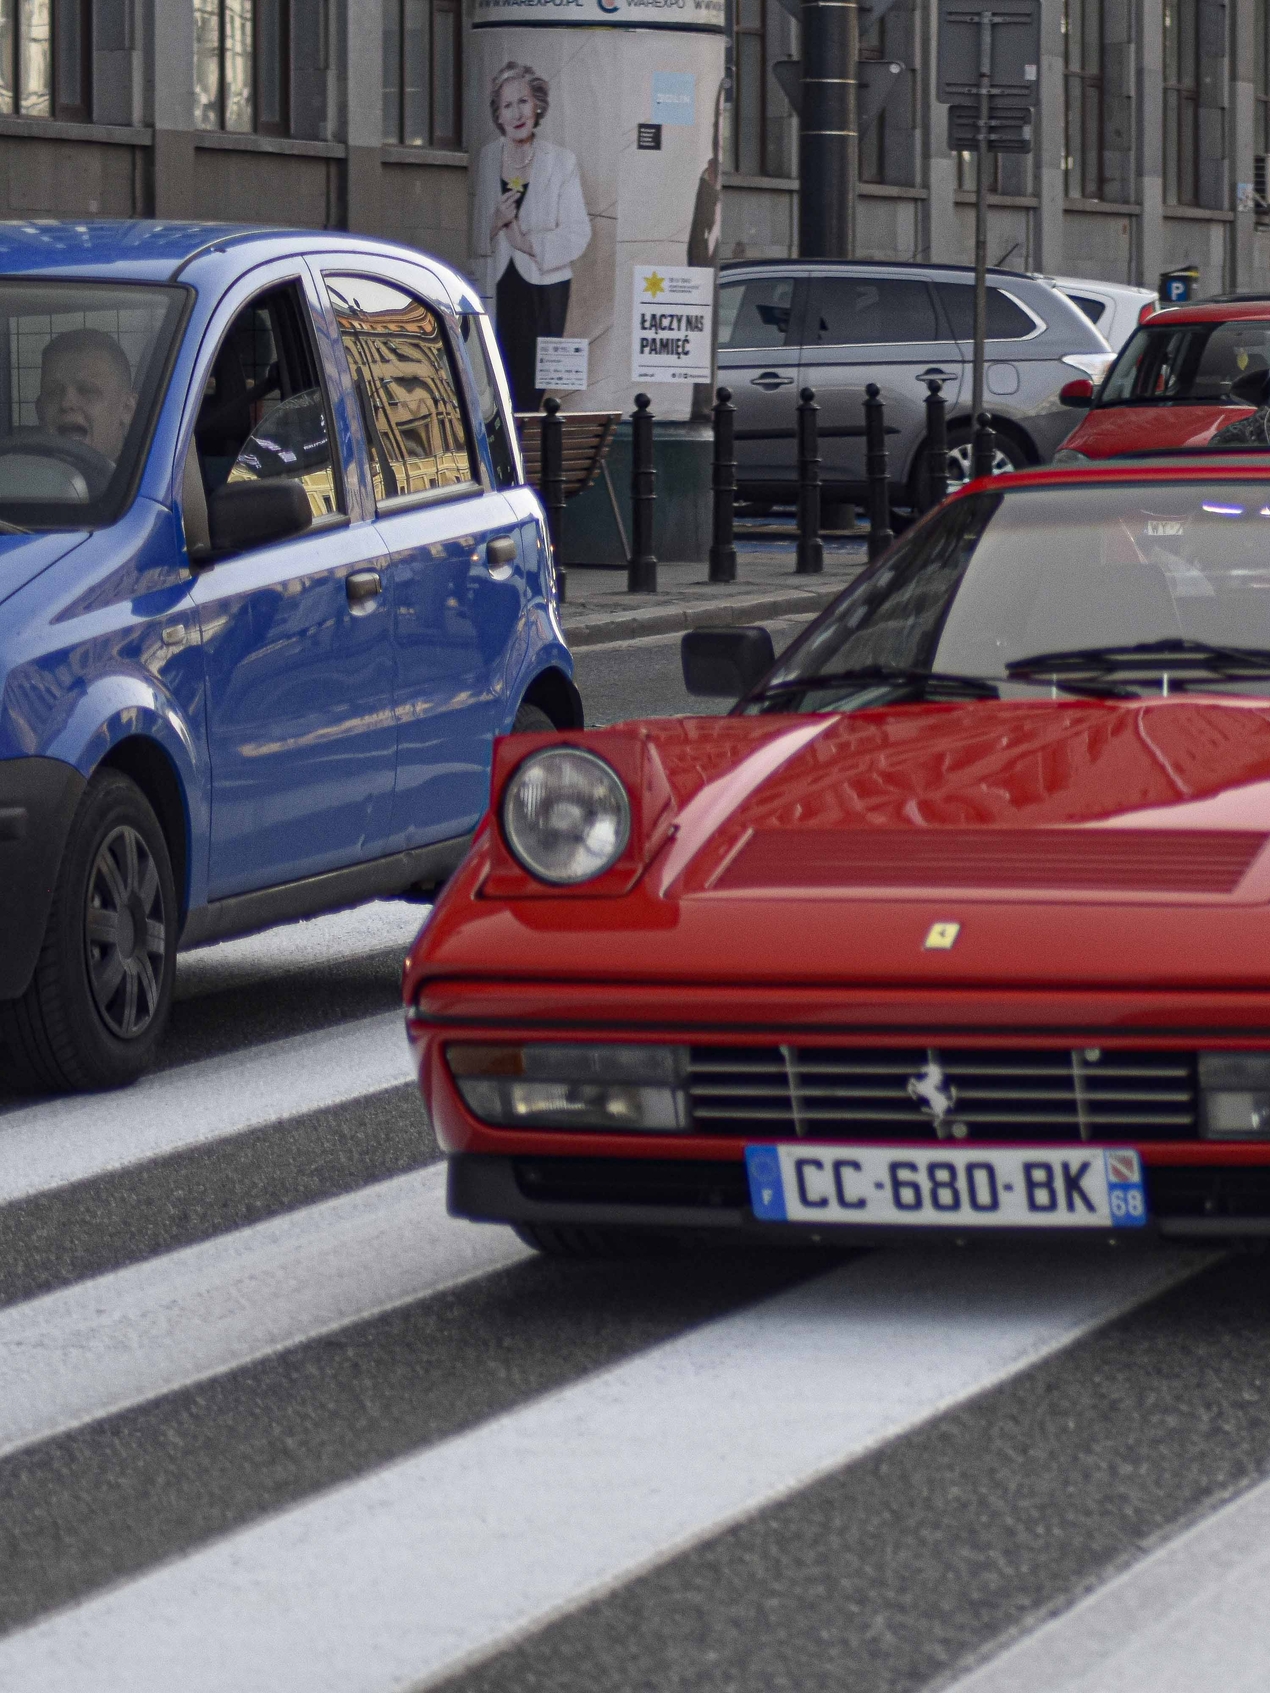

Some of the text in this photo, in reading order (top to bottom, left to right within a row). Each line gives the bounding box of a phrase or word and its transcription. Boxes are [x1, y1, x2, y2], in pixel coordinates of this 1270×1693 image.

[1171, 283, 1185, 301] P
[640, 313, 704, 334] ŁĄCZY NAS
[639, 335, 690, 359] PAMIĘĆ
[762, 1158, 1142, 1217] F CC-680-BK 68
